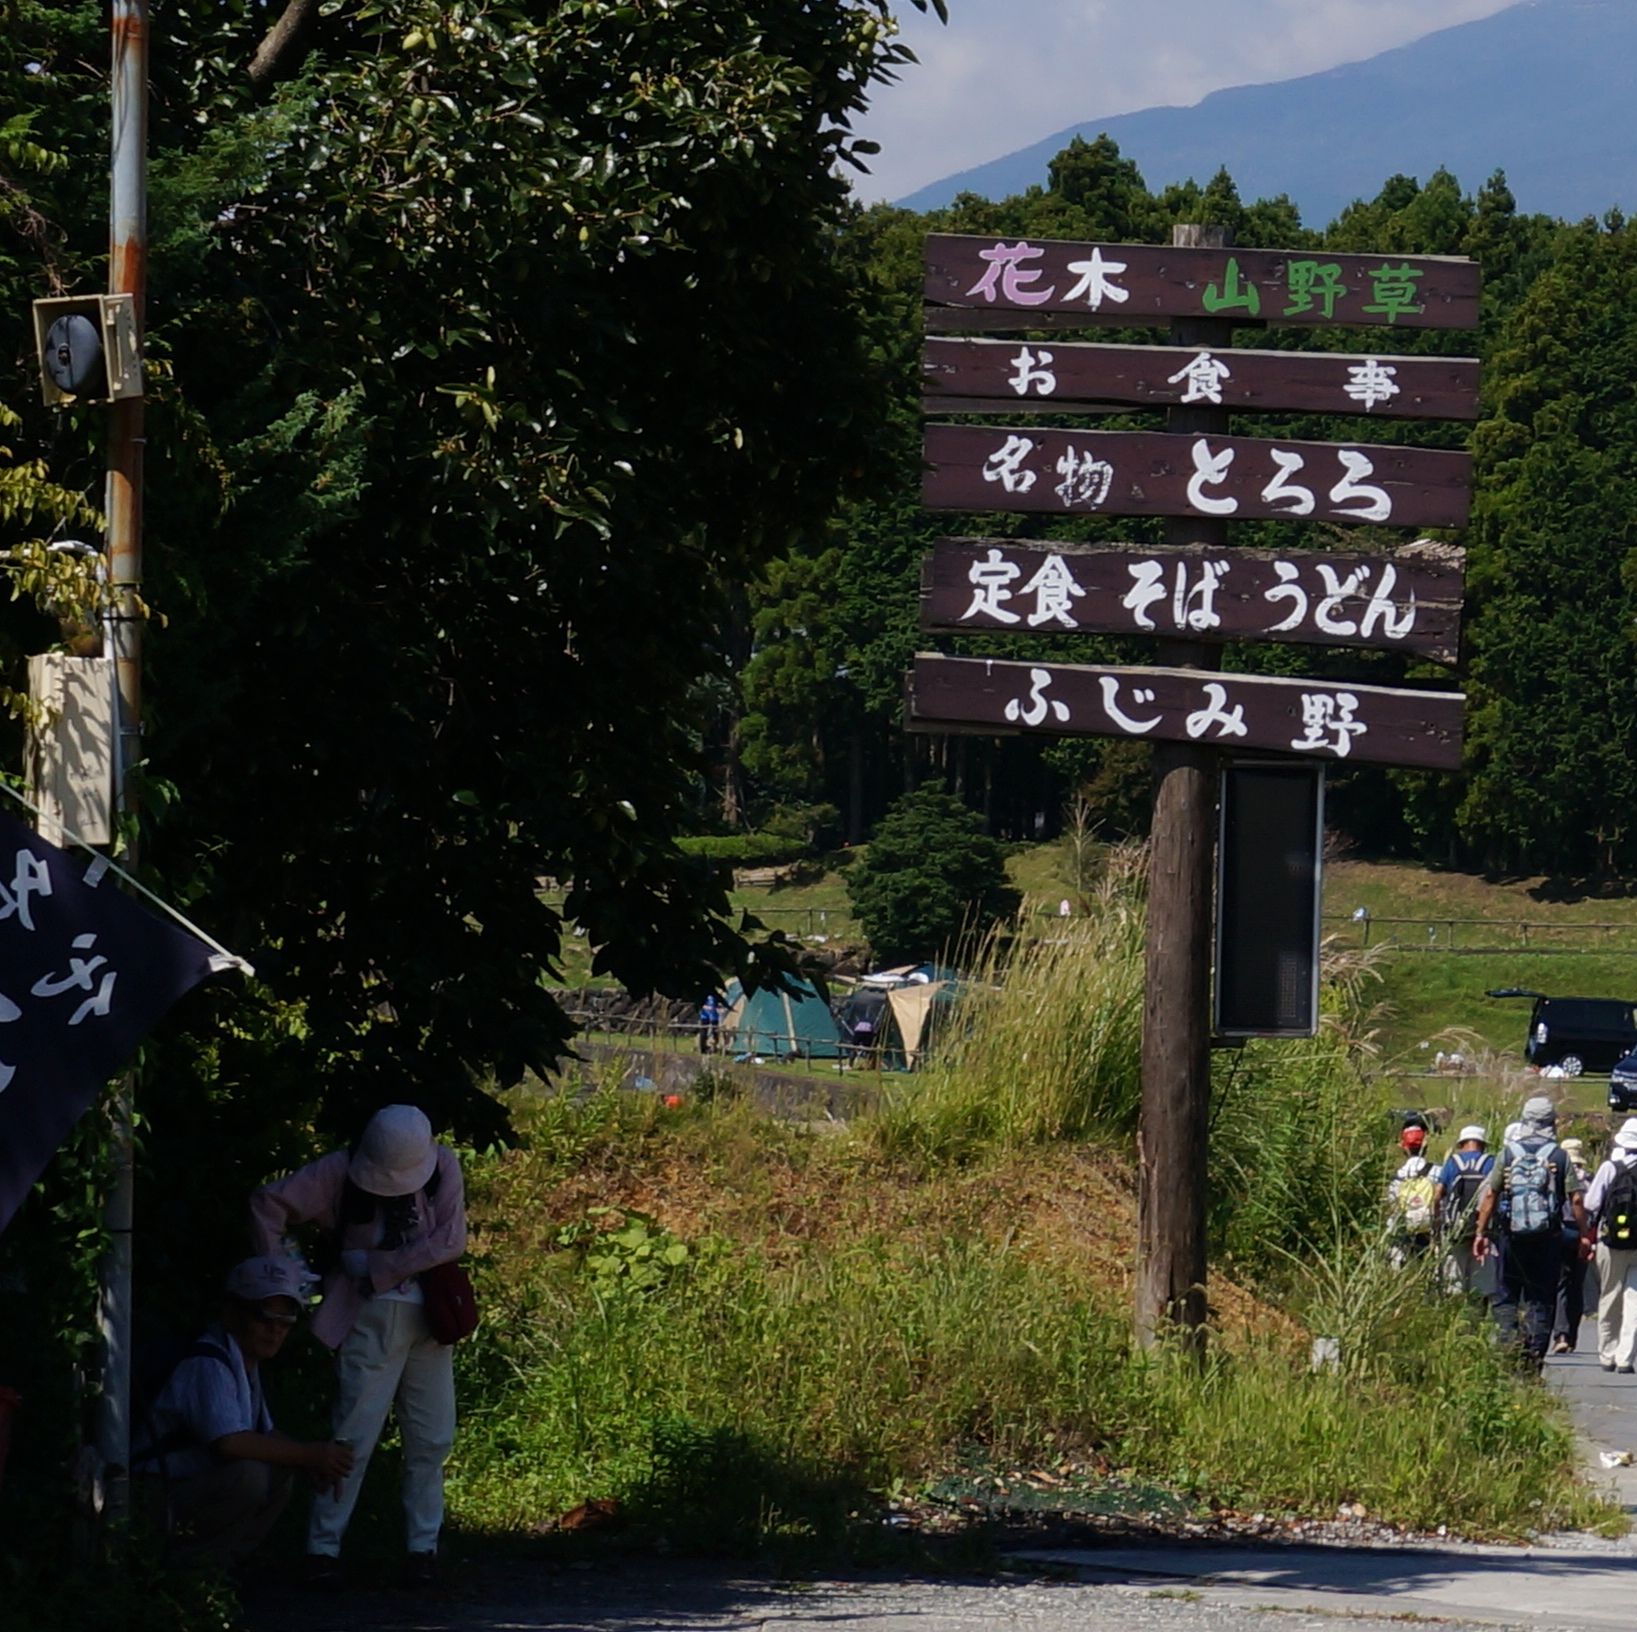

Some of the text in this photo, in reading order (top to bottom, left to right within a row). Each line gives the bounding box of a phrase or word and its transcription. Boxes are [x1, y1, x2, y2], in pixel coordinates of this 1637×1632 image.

[967, 242, 1424, 323] 花木 山野草
[1008, 346, 1400, 409] お食事
[983, 435, 1391, 521] 名物 とろろ
[961, 549, 1416, 639] 定食 そば うどん
[1005, 668, 1368, 757] ふじみ野
